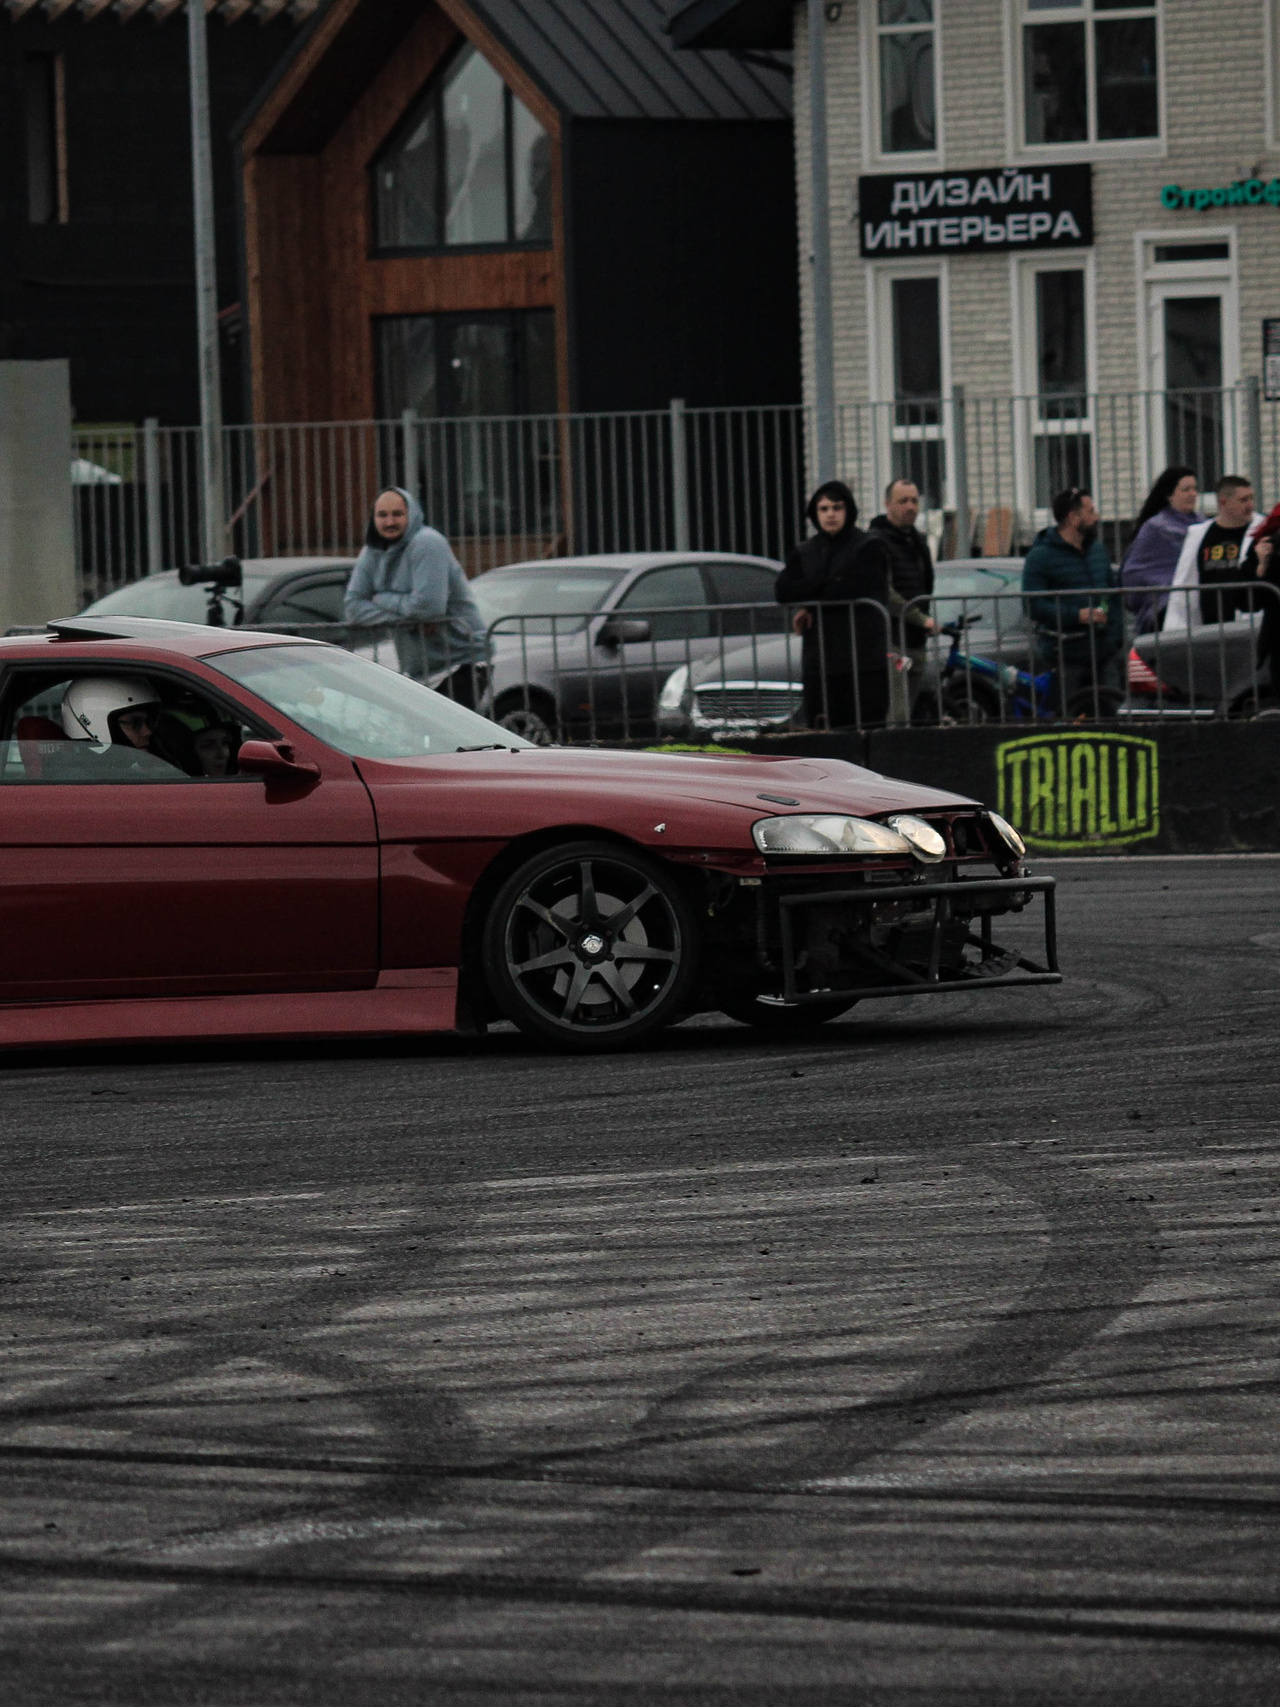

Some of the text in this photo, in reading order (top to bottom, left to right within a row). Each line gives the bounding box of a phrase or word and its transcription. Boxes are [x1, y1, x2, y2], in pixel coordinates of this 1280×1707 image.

[891, 168, 1051, 215] ДИЗАЙН
[864, 210, 1081, 250] ИНТЕРЬЕРА
[1006, 743, 1147, 836] TRIALLI
